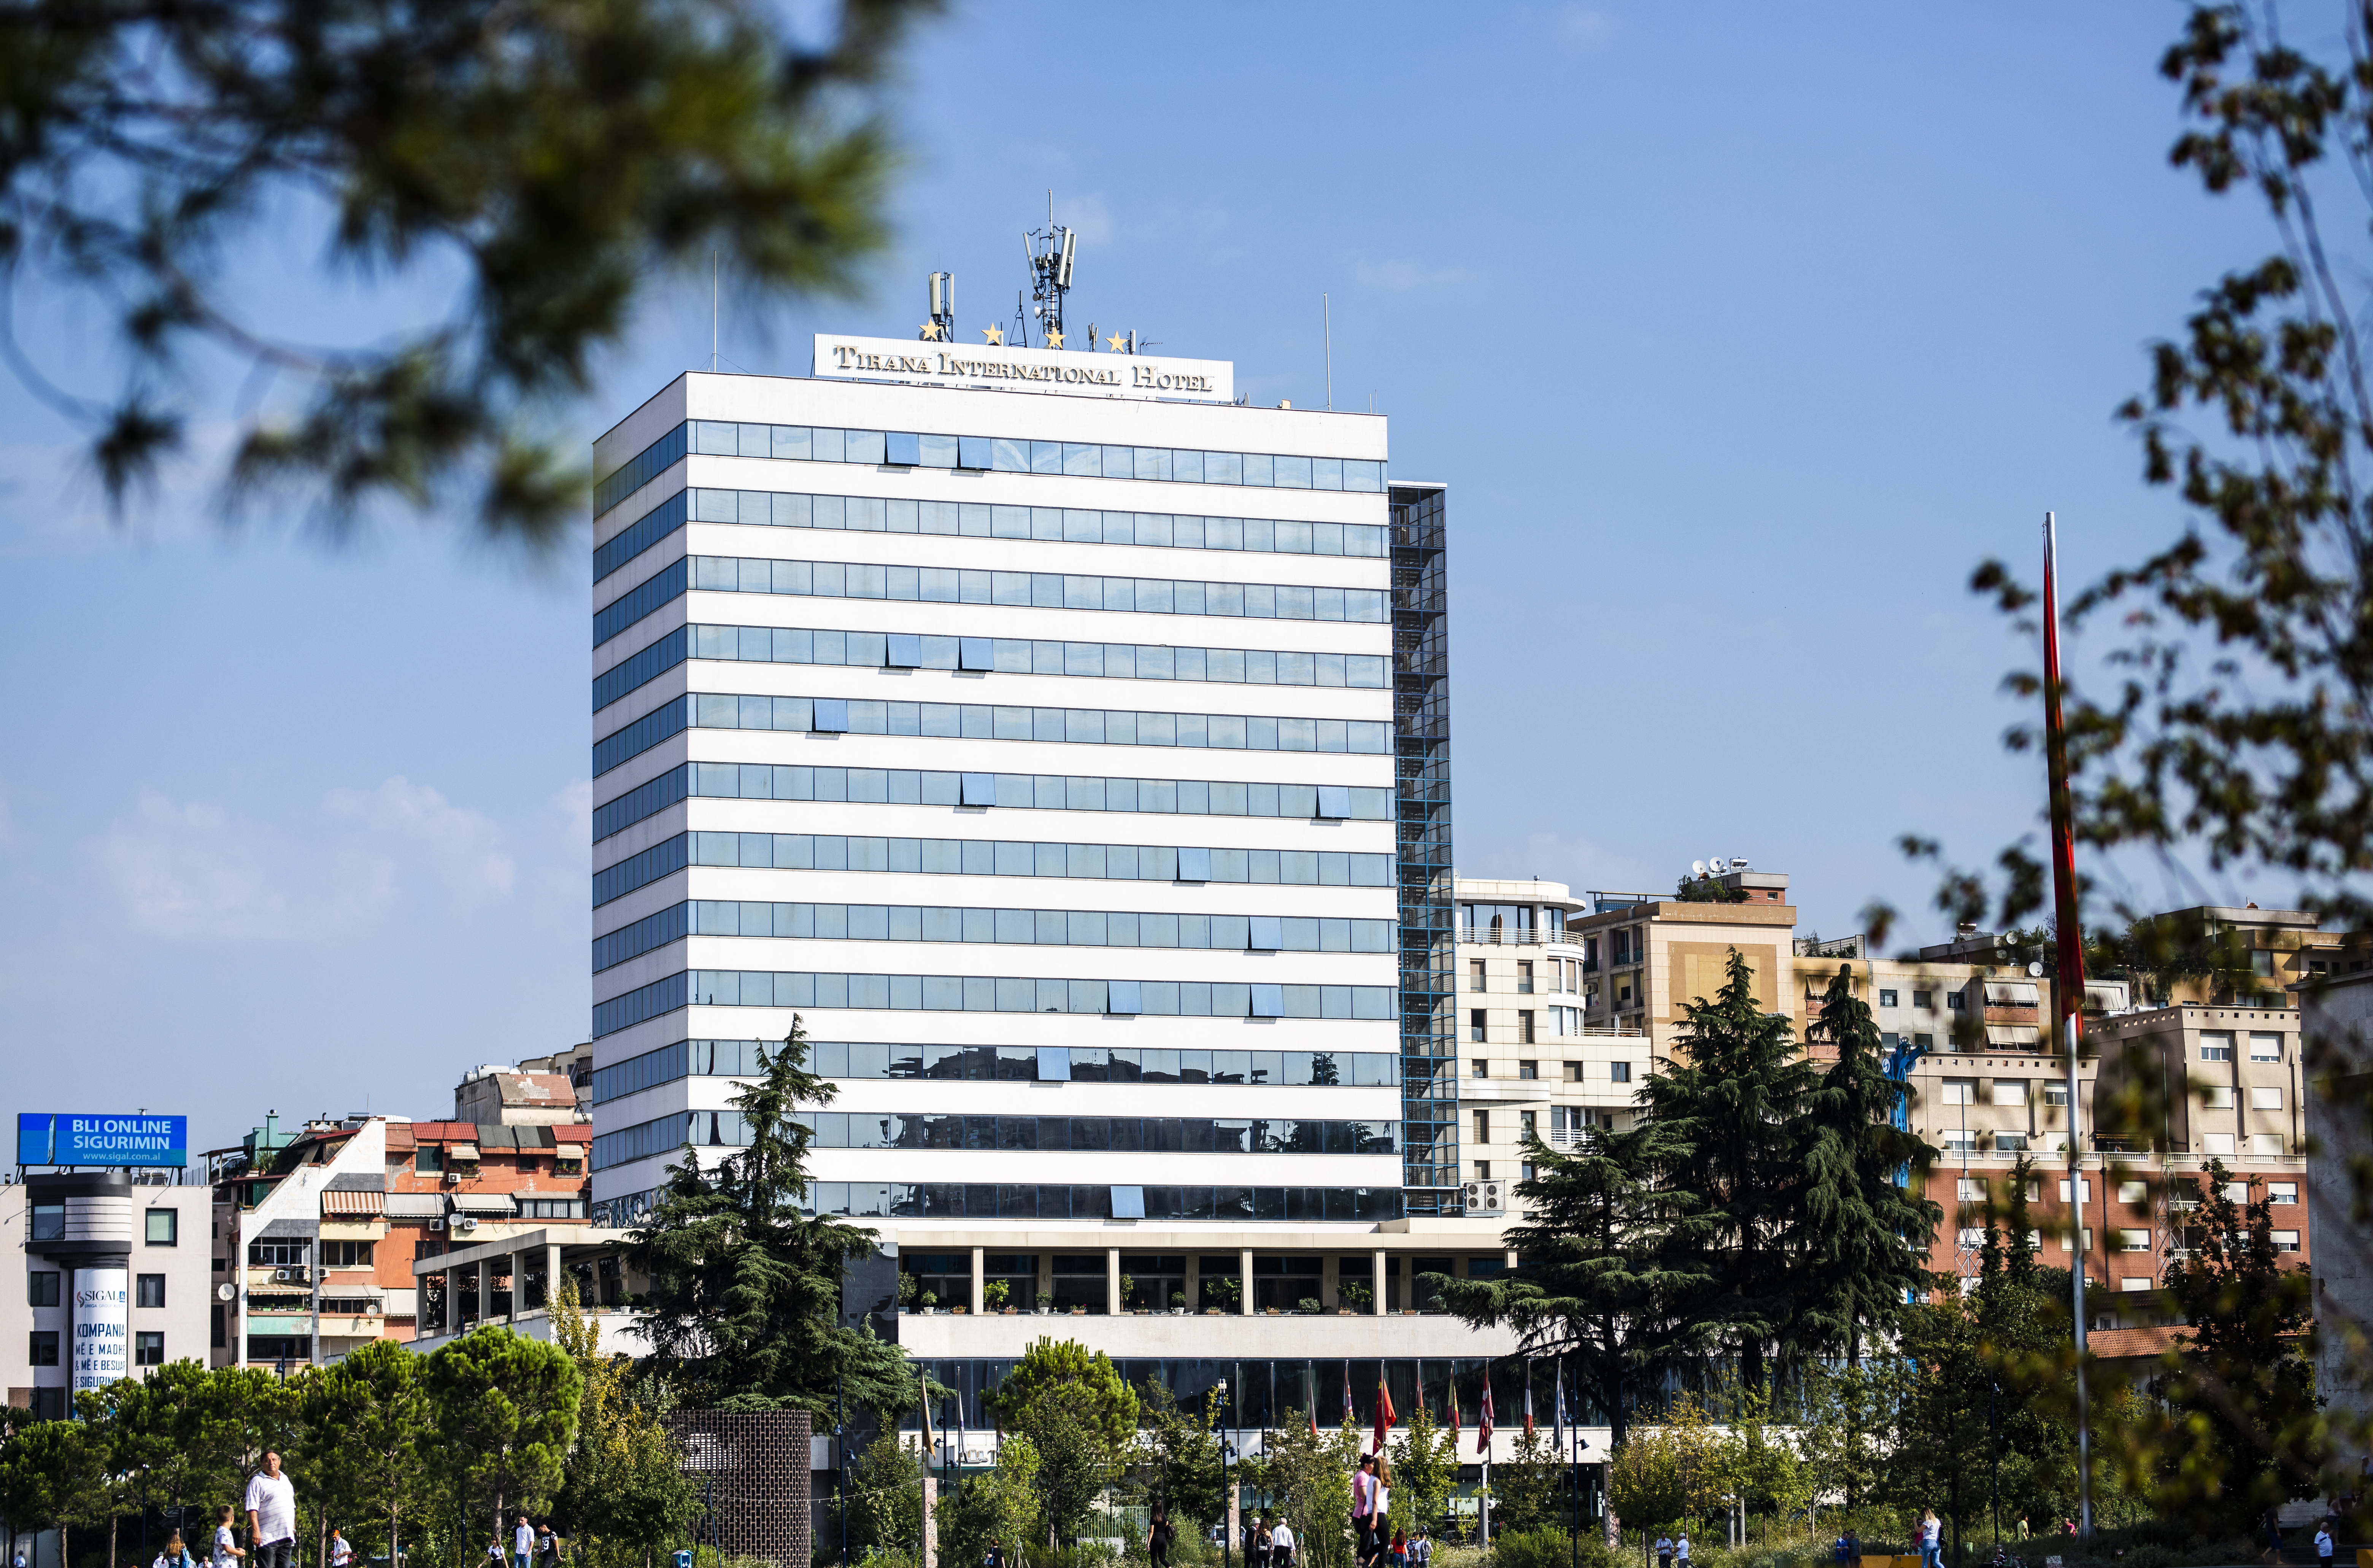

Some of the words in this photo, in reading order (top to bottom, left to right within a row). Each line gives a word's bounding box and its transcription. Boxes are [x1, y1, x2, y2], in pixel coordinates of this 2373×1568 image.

[836, 345, 932, 372] TIRANA
[940, 352, 1122, 384] INTERNATIONAL
[1133, 365, 1213, 391] HOTEL
[73, 1120, 99, 1133] BLI
[104, 1120, 171, 1133] ONLINE
[73, 1136, 169, 1150] SIGURIMIN
[83, 1152, 160, 1161] www.sigal.com.al
[85, 1290, 118, 1301] SIGAL
[77, 1323, 125, 1338] KOMPANIA
[76, 1342, 85, 1355] MË
[89, 1344, 94, 1355] E
[99, 1344, 125, 1355] MADHE
[75, 1360, 79, 1371] &
[81, 1358, 91, 1370] MË
[94, 1360, 98, 1370] E
[101, 1360, 125, 1370] BESUAR
